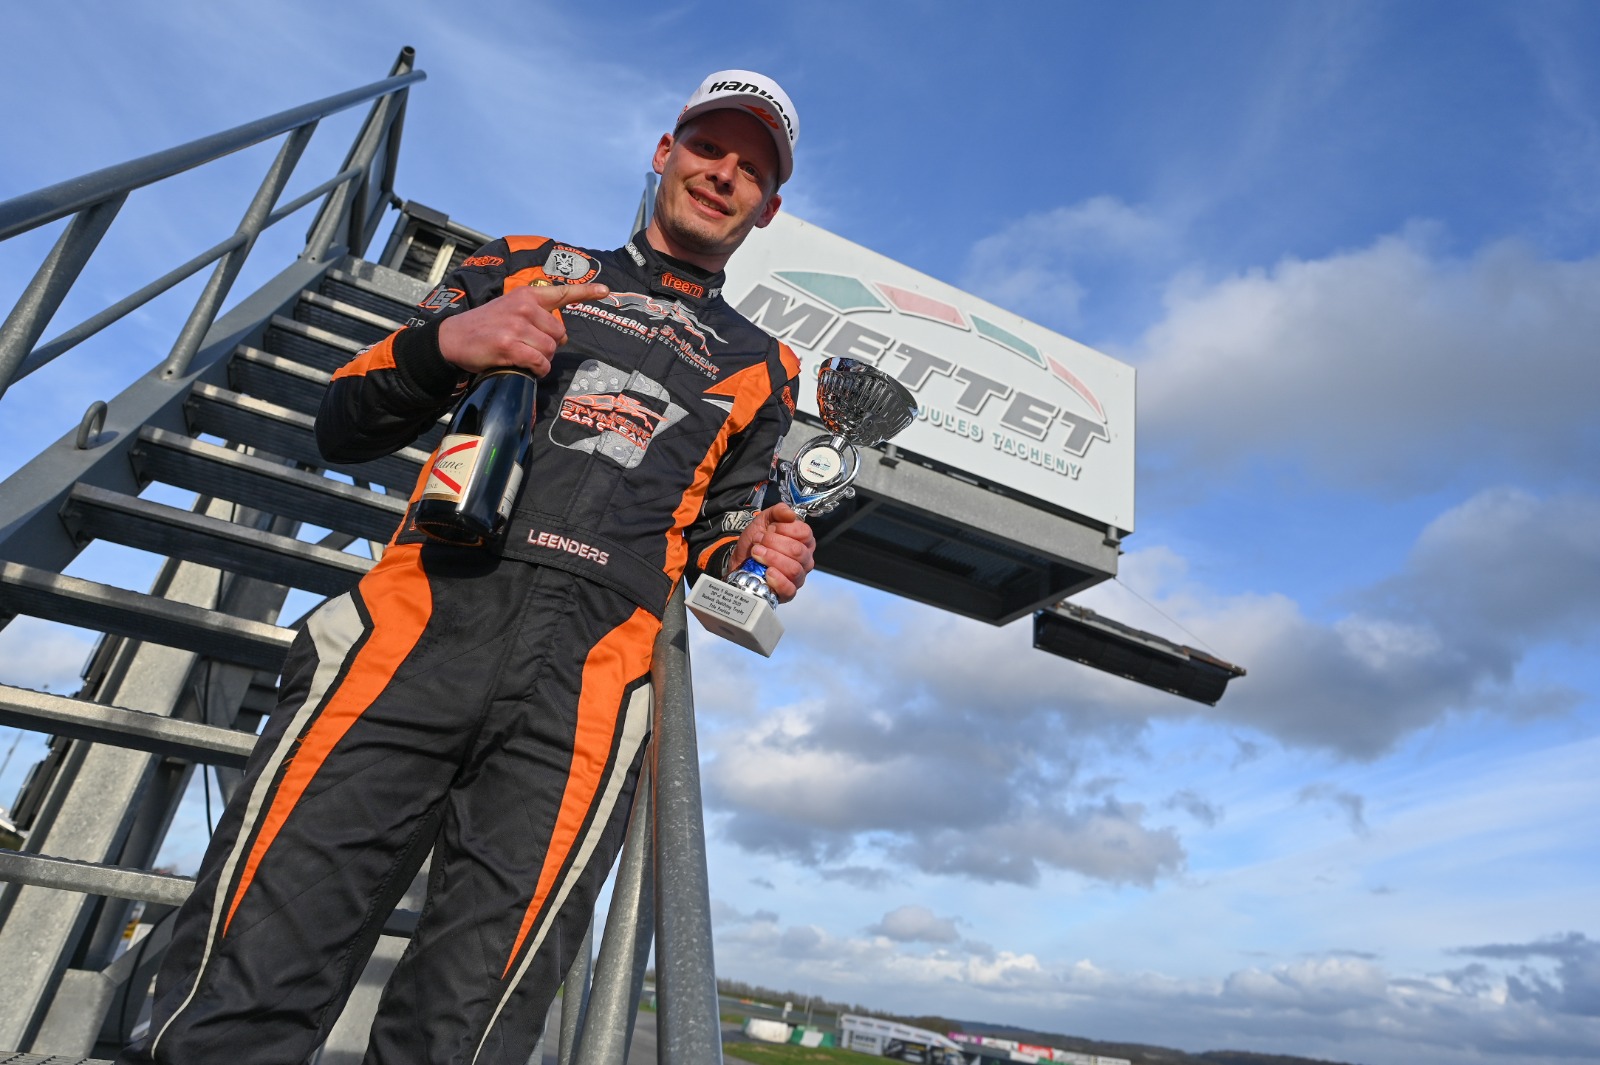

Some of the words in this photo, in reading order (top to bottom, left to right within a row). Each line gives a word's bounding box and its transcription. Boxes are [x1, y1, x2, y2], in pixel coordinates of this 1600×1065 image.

[662, 271, 704, 298] freem
[565, 302, 648, 335] CARROSSERIE
[734, 283, 1110, 457] METTET
[560, 410, 594, 428] CAR
[918, 404, 980, 440] JULES
[992, 431, 1081, 477] TACHENY
[527, 528, 610, 566] LEENDERS
